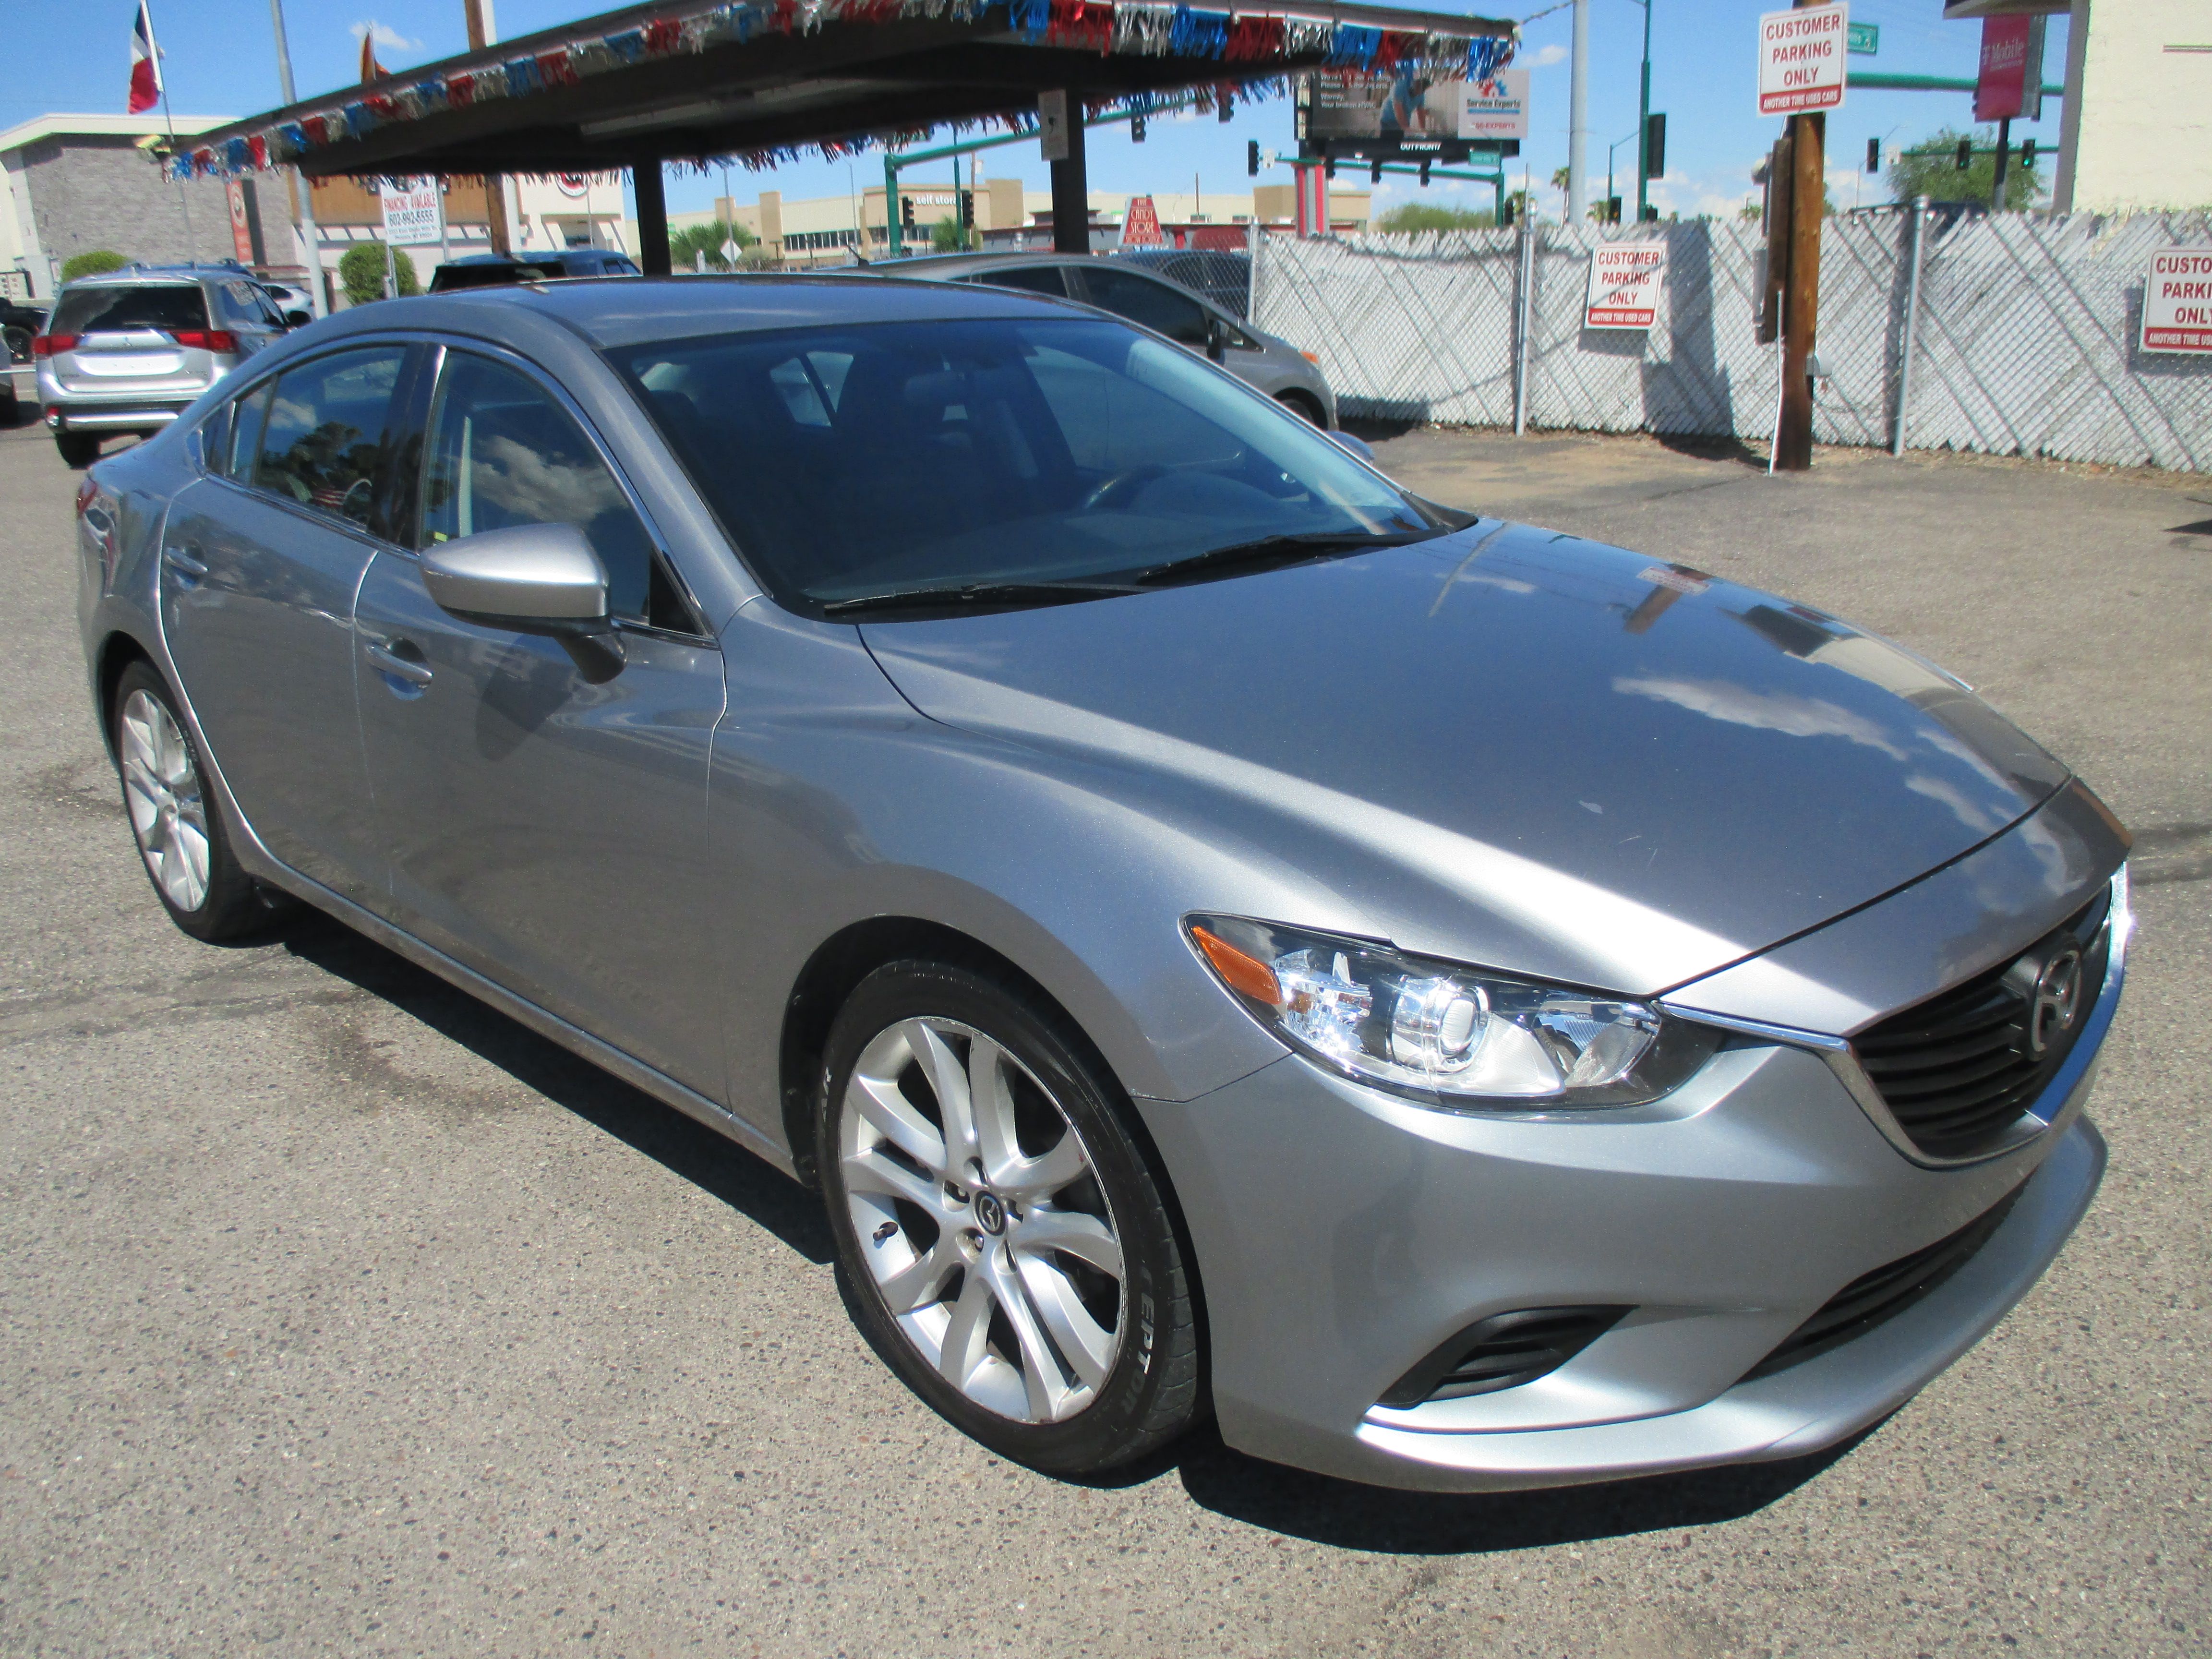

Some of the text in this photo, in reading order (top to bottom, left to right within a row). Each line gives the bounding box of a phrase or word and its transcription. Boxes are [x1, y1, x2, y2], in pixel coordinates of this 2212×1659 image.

[1766, 15, 1840, 40] CUSTOMER
[1772, 40, 1832, 64] PARKING
[1783, 67, 1819, 86] ONLY
[1467, 99, 1521, 109] Service Experts
[1763, 91, 1838, 109] ANOTHER TIME USED CARS
[916, 193, 957, 205] self stora
[389, 209, 434, 227] 602-992-5555
[1131, 209, 1154, 221] CANDY
[1130, 221, 1154, 233] STORE
[1598, 252, 1659, 265] CUSTOMER
[2156, 257, 2212, 274] CUSTO
[1601, 272, 1650, 285] PARKING
[2162, 282, 2212, 299] PARKI
[1609, 291, 1638, 305] ONLY
[1591, 313, 1651, 322] ANOTHER TIME USED CARS
[2148, 333, 2212, 346] ANOTHER TIME US
